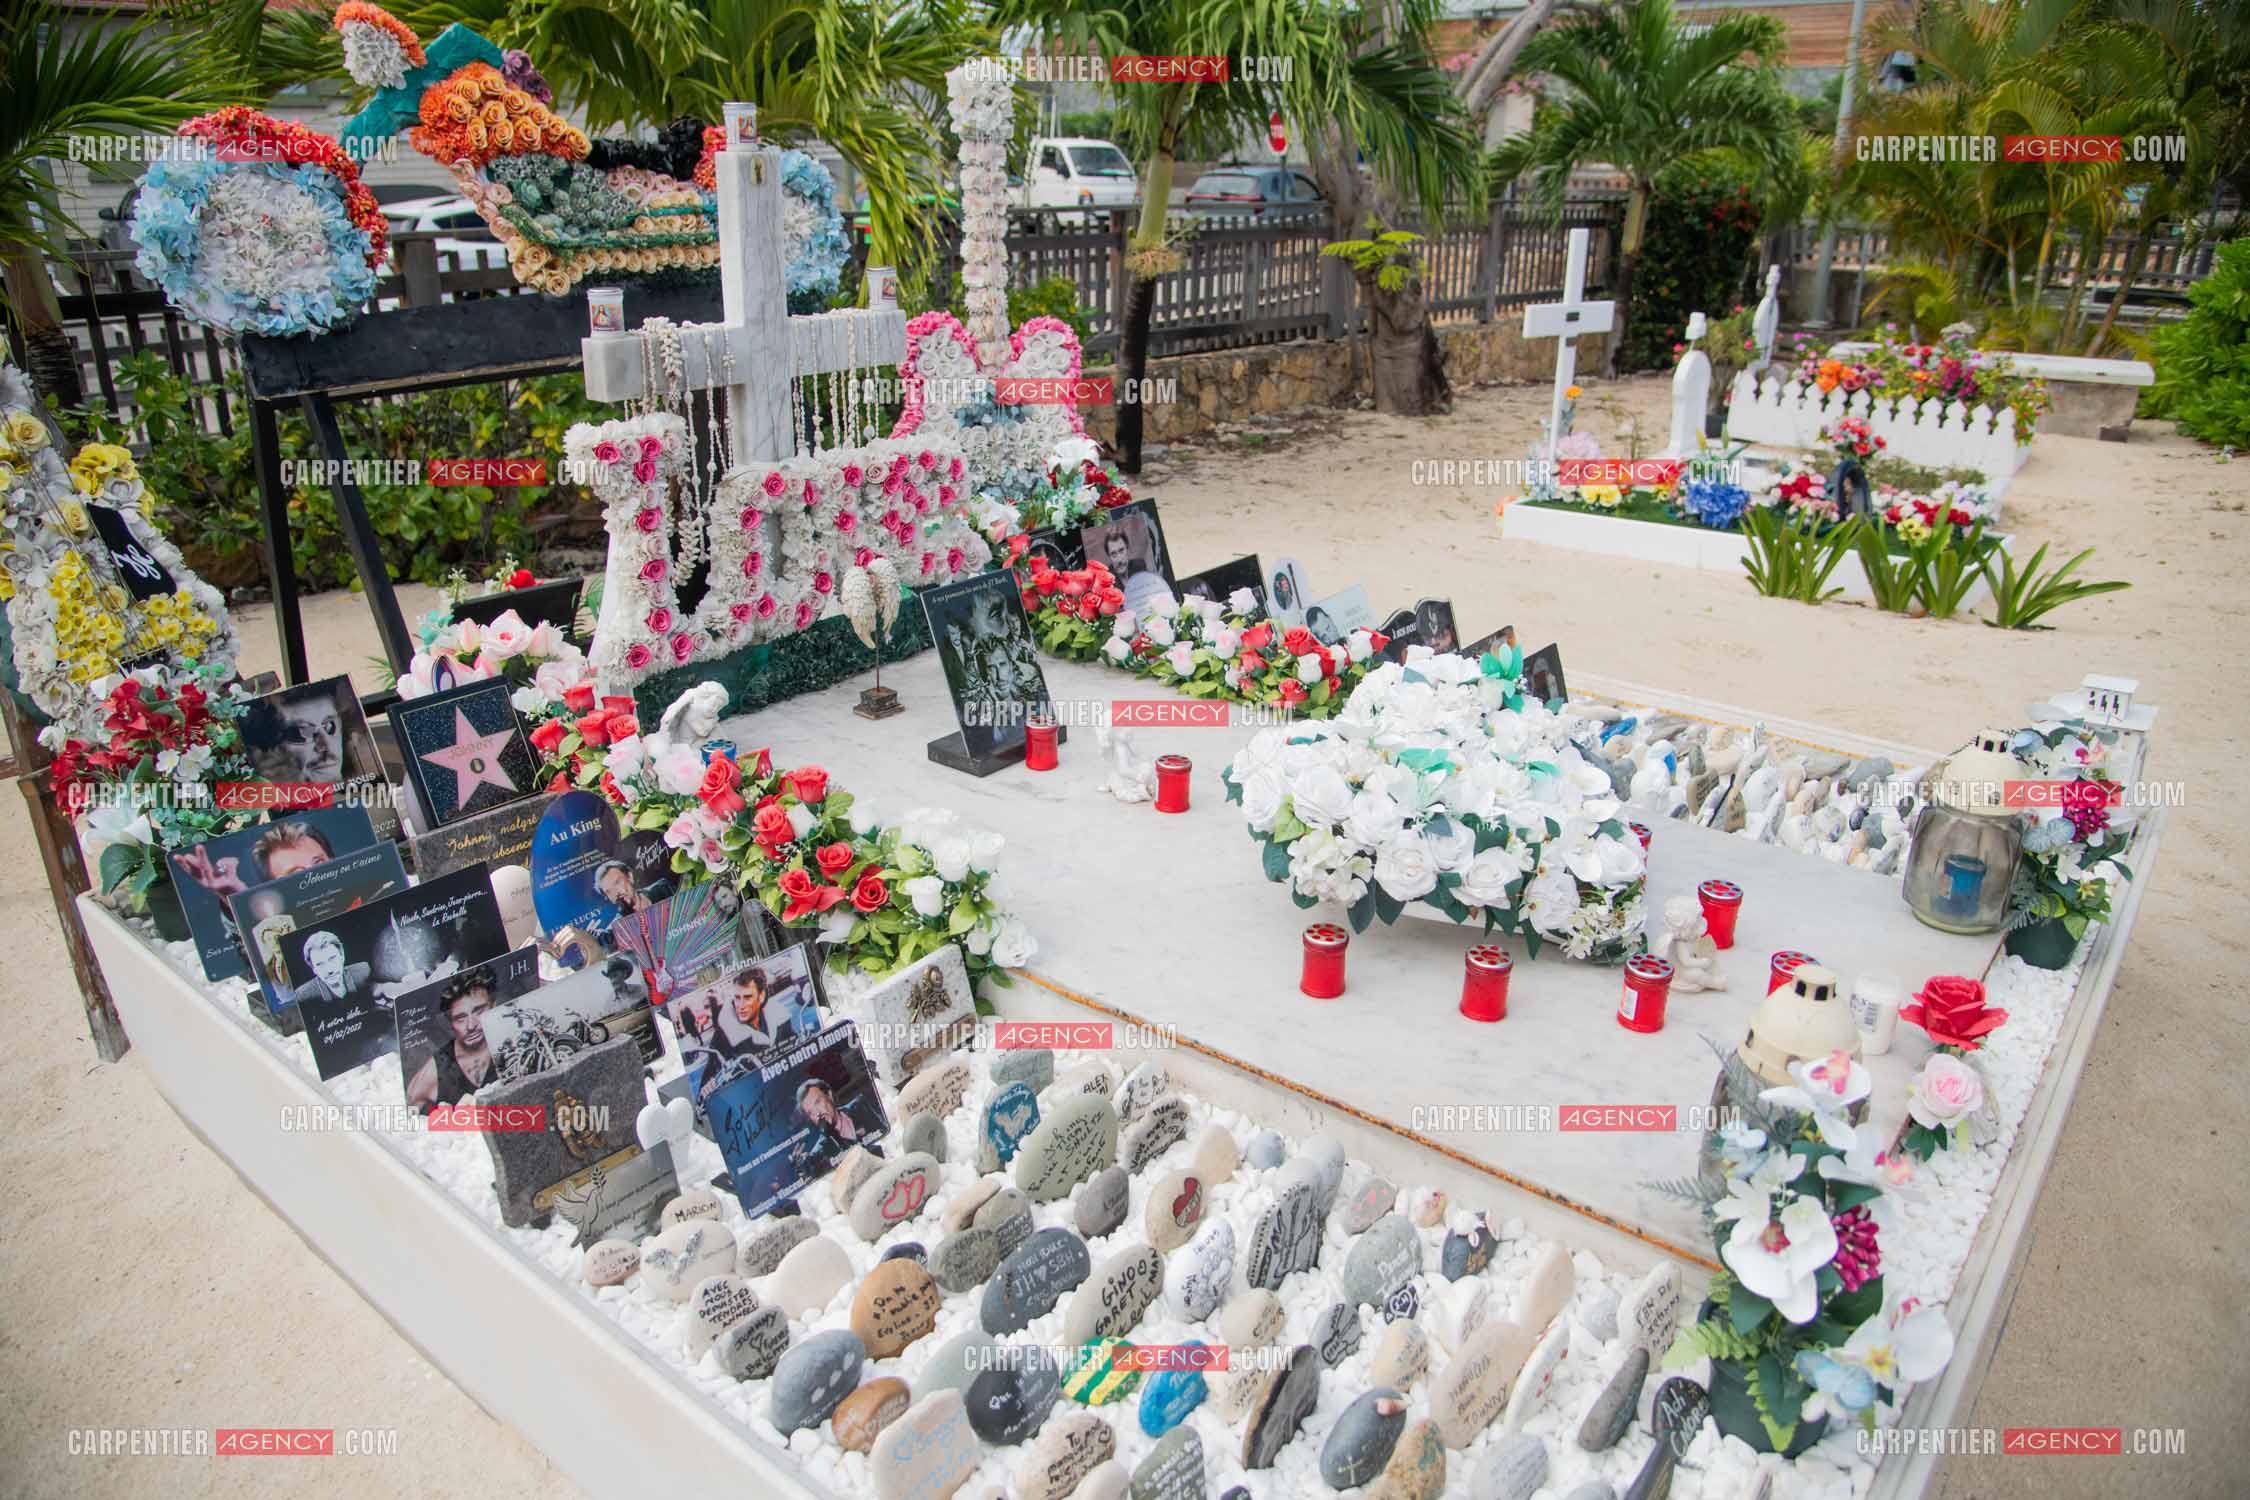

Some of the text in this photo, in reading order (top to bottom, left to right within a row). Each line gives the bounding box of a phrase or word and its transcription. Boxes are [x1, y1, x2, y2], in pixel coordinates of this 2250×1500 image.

[550, 815, 603, 846] Au King
[299, 867, 339, 891] Johnny
[509, 959, 532, 982] J.H.
[760, 1061, 790, 1083] Avec
[790, 1045, 819, 1070] notre
[675, 1202, 717, 1223] MARION
[703, 1279, 729, 1299] AVEC
[705, 1288, 733, 1307] NOUS
